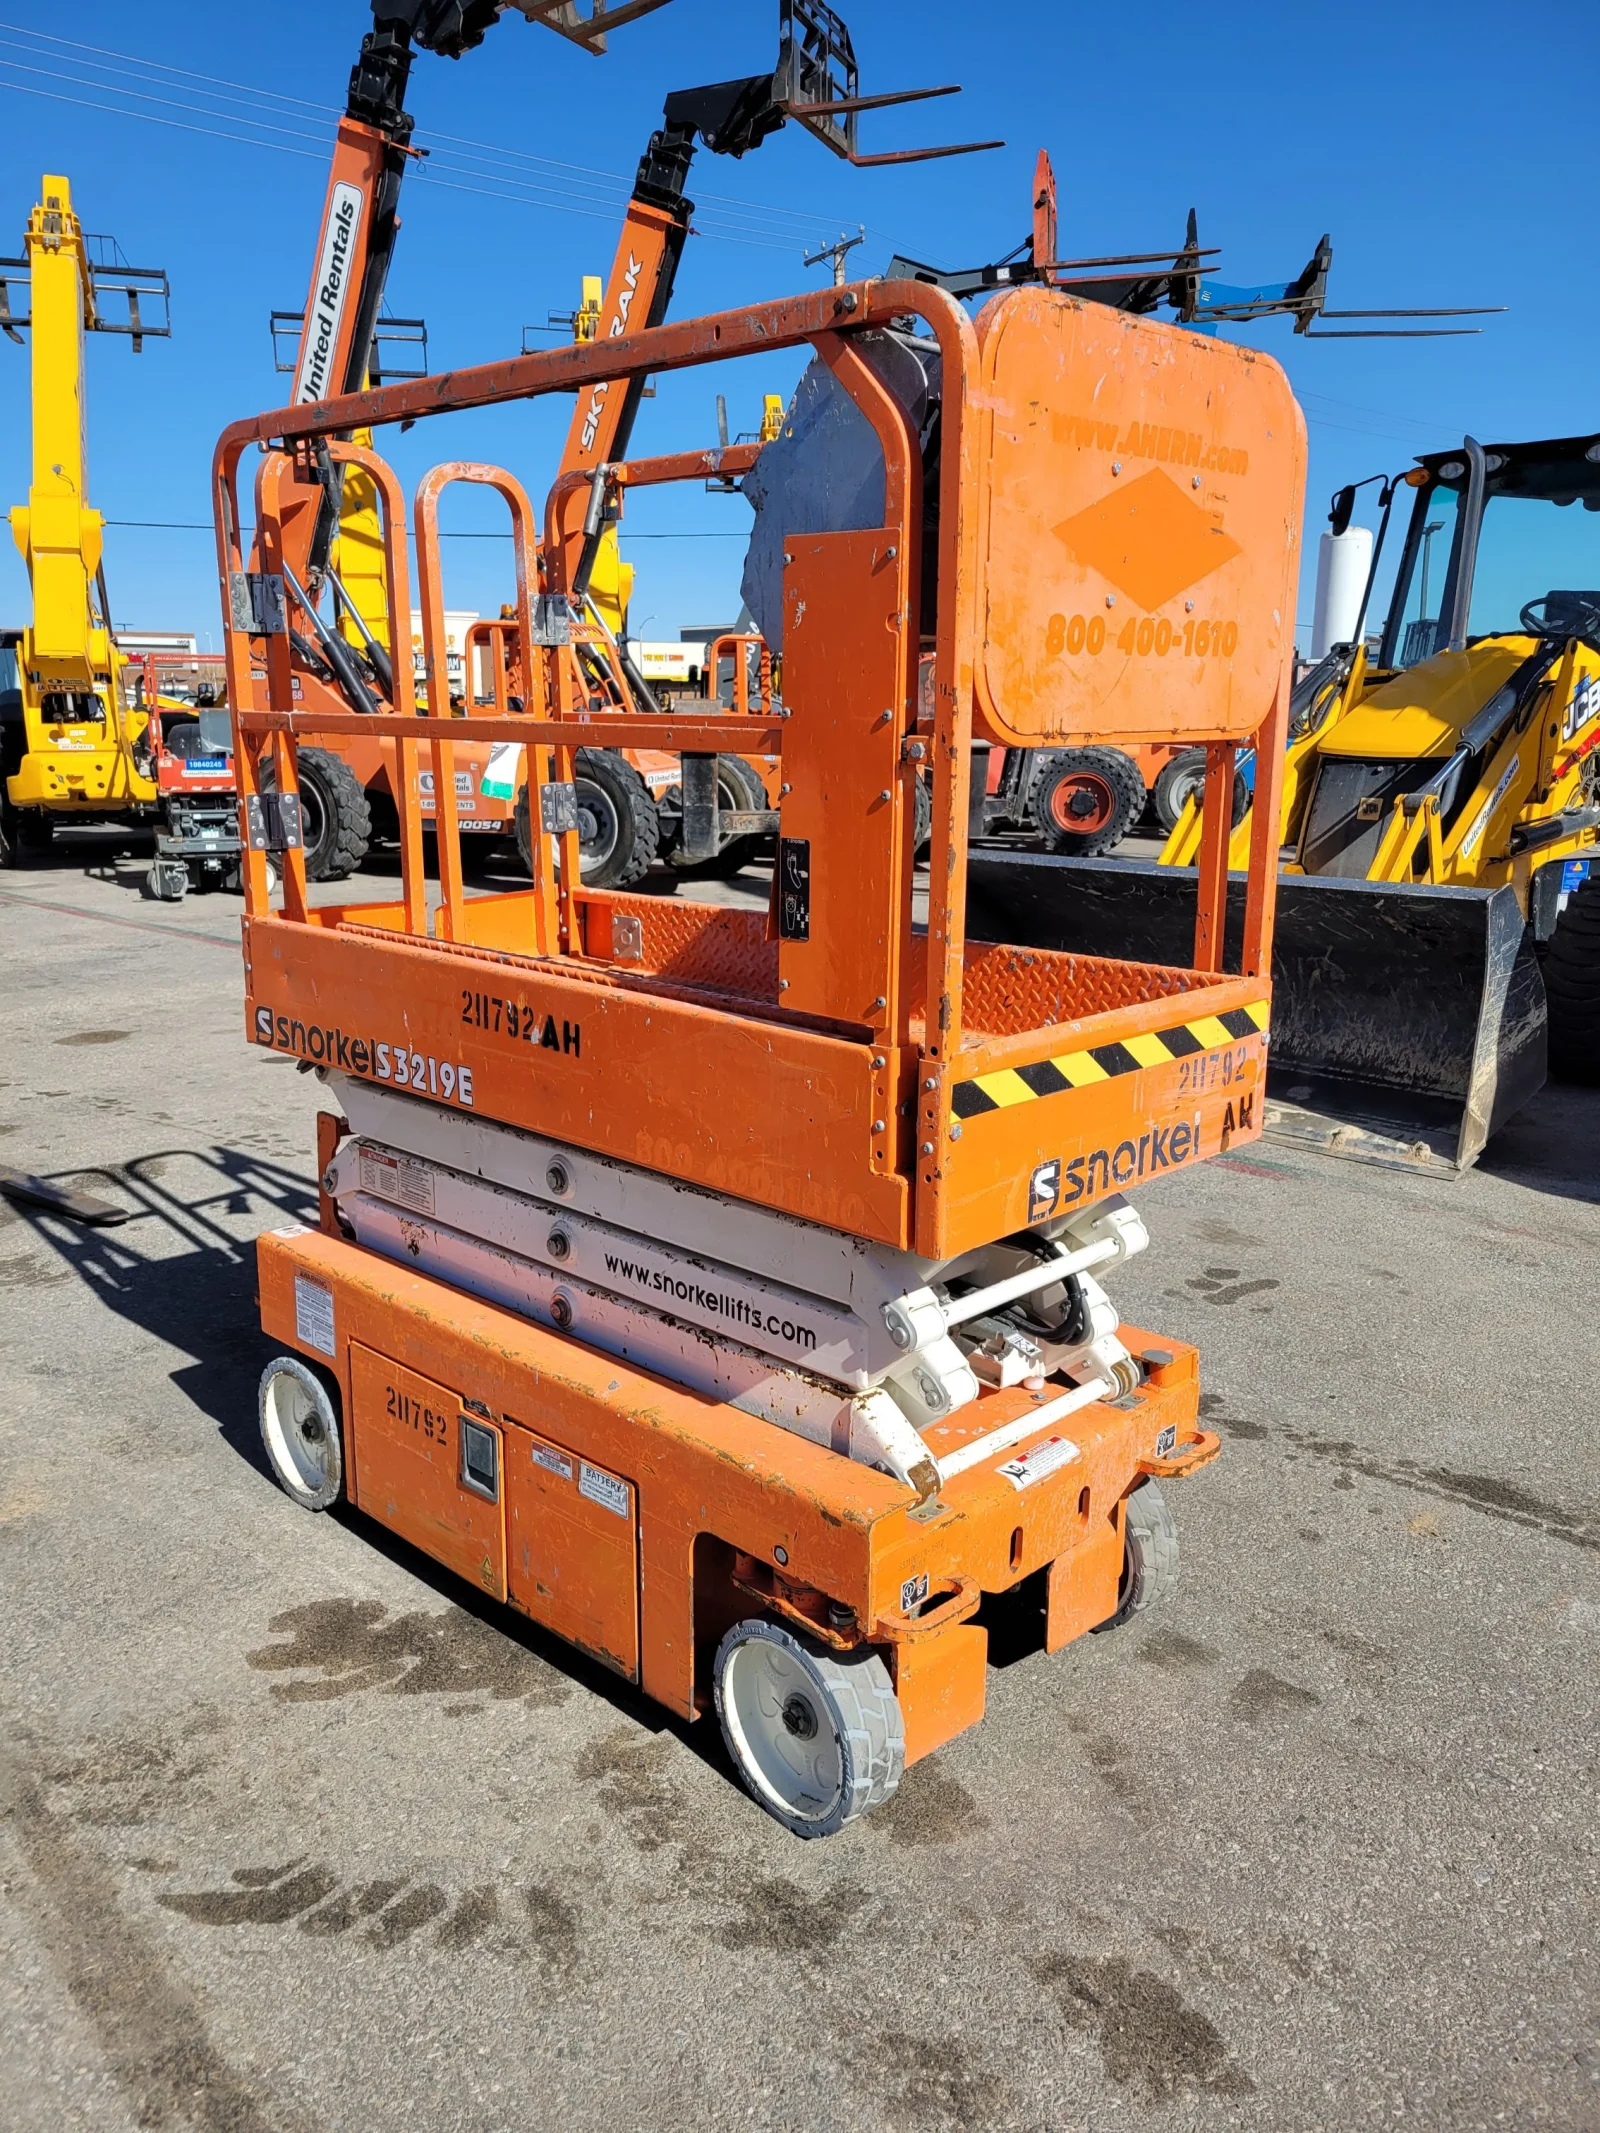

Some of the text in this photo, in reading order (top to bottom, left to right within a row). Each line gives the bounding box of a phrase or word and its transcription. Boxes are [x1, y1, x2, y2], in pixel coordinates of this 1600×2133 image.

[303, 199, 354, 403] United Rentals
[581, 249, 643, 452] SKYRAK
[1564, 680, 1600, 741] JCB
[1463, 757, 1519, 855] UnitedRentals.com
[276, 1016, 377, 1077] snorkel
[376, 1042, 474, 1107] S3219E
[461, 990, 581, 1058] 211792 AH
[1179, 1046, 1248, 1093] 211792
[1065, 1111, 1201, 1203] snorkel
[604, 1253, 817, 1350] www.snorkellifts.com
[386, 1386, 447, 1447] 211792
[585, 1467, 622, 1493] BATTERY
